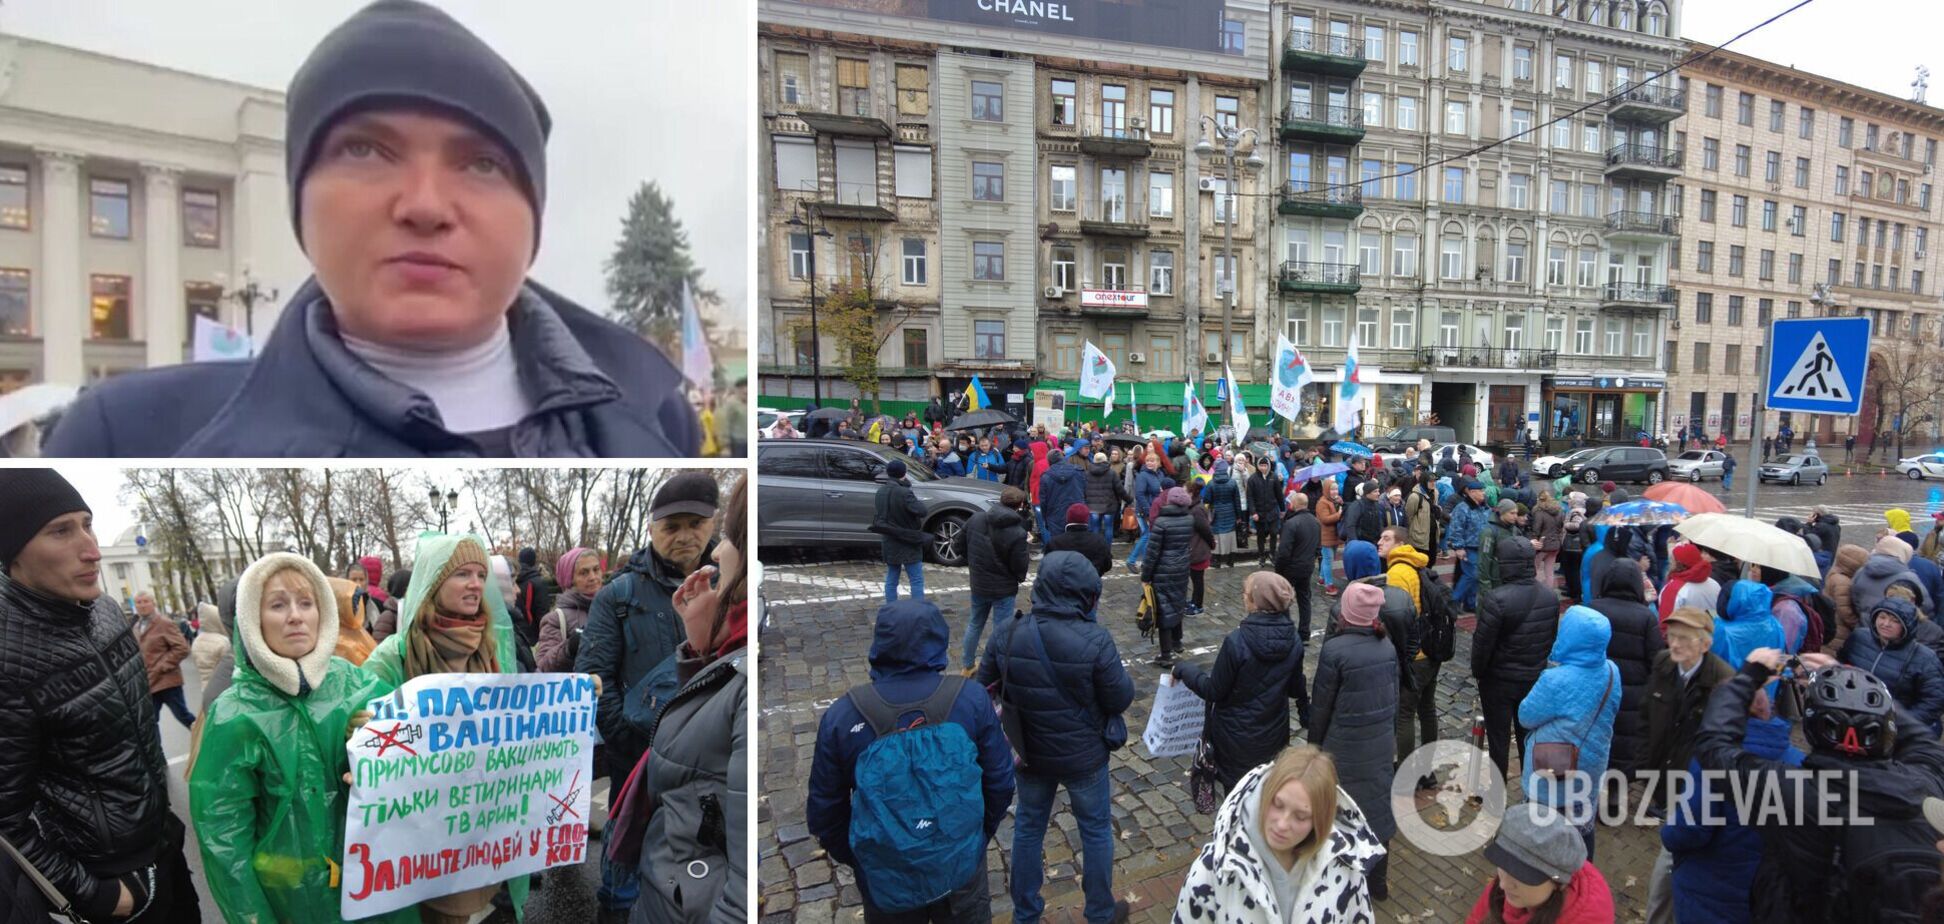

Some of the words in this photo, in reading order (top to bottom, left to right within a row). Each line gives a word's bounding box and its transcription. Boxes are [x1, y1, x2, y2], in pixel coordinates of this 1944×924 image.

[977, 0, 1074, 22] CHANEL
[417, 677, 596, 718] ПАСПОРТАМ
[428, 702, 597, 752] ВАЦІНАЦІЇ!
[357, 750, 475, 788] ПРИМУСОВО
[485, 739, 579, 771] ВАКЦІНУЮТЬ
[358, 788, 439, 827] ТІЛЬКИ
[449, 767, 563, 808] ВЕТИРИНАРИ
